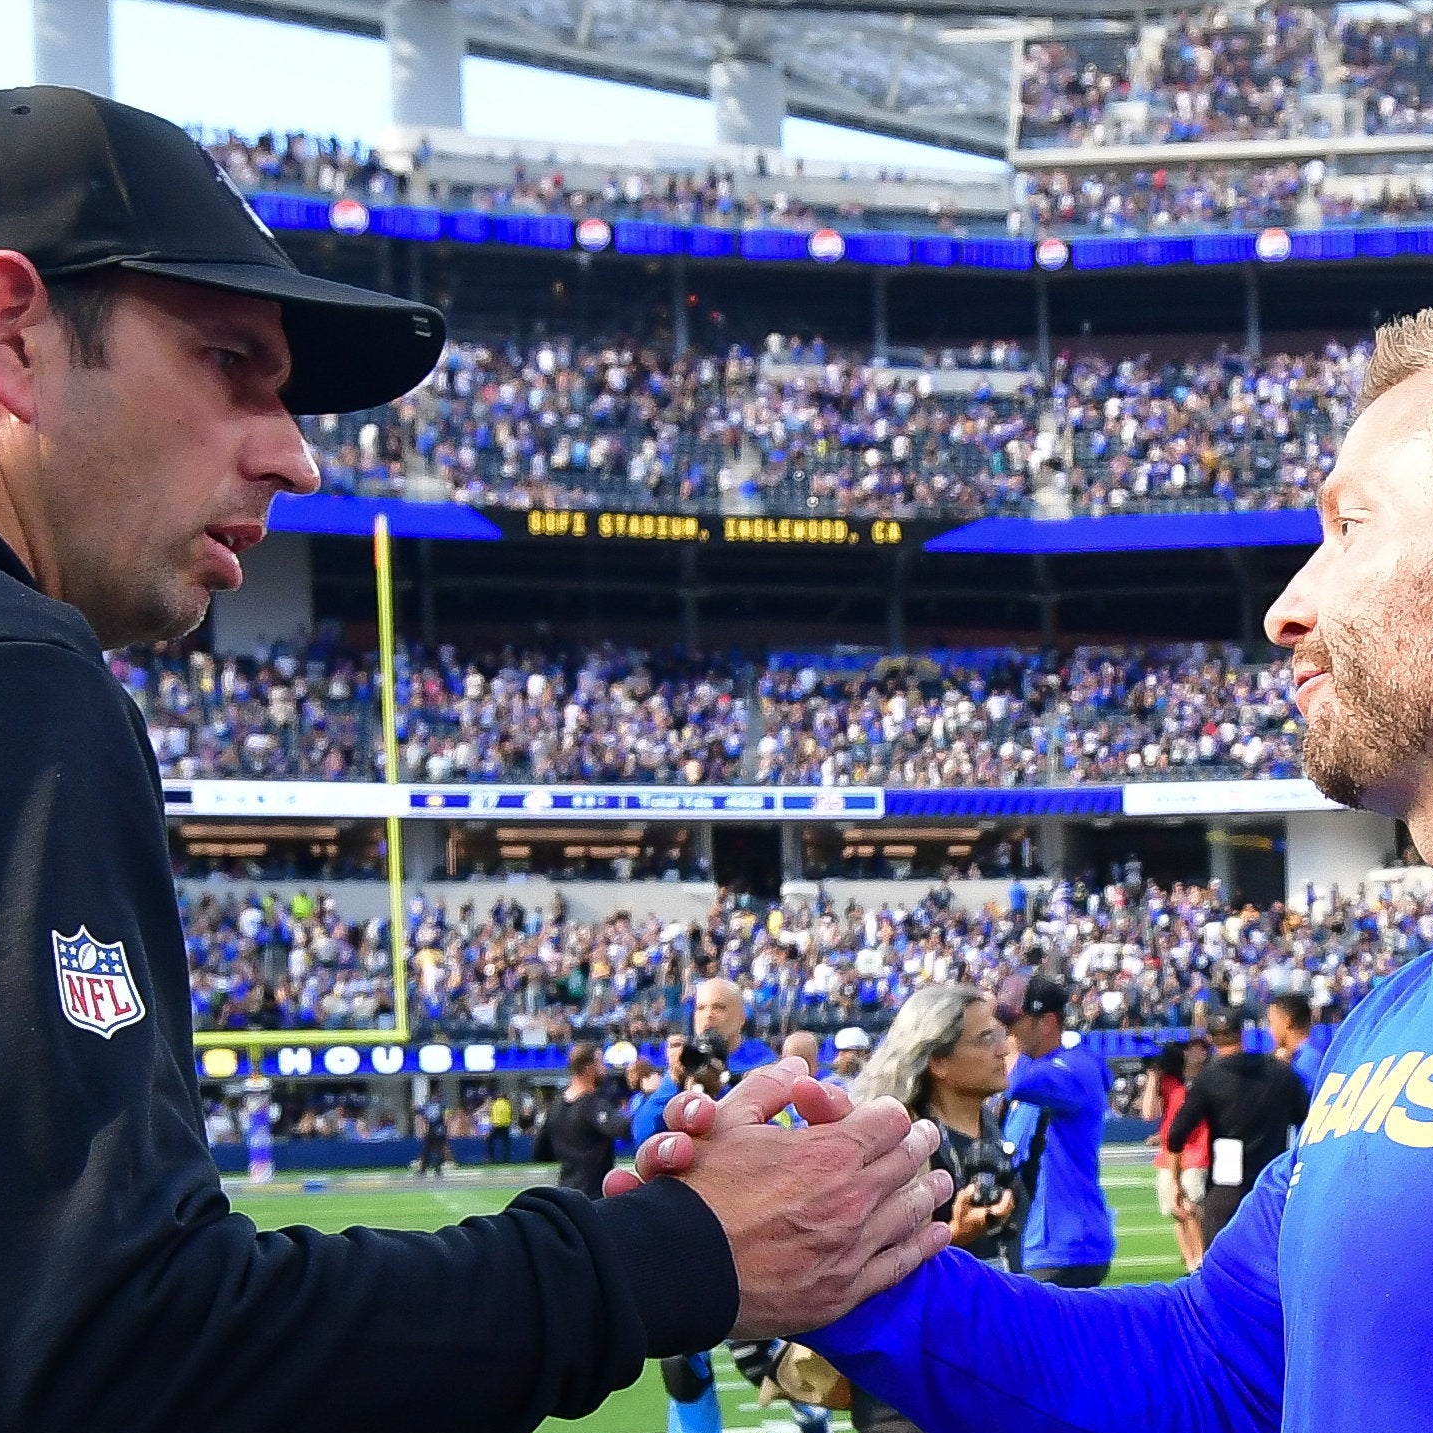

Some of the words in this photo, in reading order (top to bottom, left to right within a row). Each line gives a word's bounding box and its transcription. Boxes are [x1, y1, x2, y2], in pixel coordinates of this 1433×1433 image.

[871, 519, 901, 543] CA
[66, 974, 132, 1022] NFL
[278, 1044, 497, 1076] HOUSE
